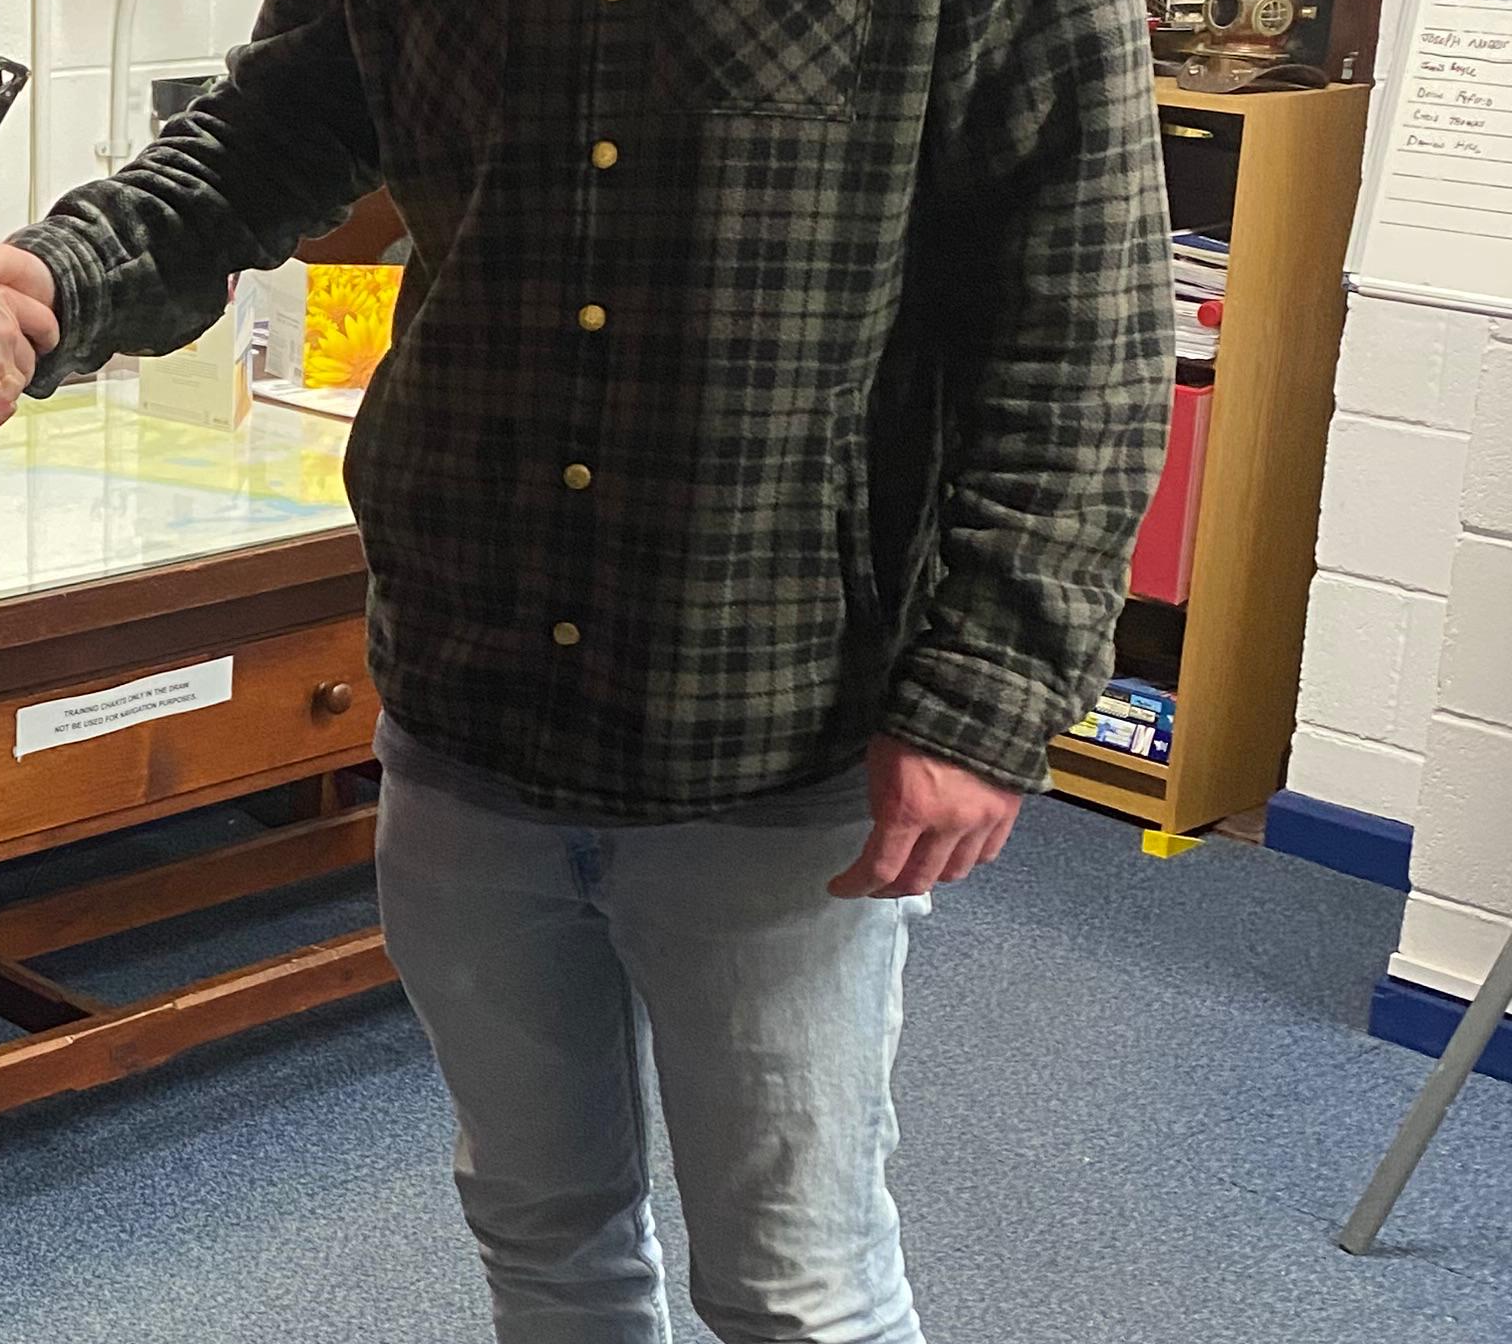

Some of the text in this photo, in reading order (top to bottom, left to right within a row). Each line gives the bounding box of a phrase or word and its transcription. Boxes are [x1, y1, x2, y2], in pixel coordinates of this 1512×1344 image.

[64, 705, 99, 718] TRAINING
[101, 698, 127, 711] CHARTS
[128, 692, 144, 703] ONLY
[145, 690, 153, 698] IN
[154, 686, 168, 697] THE
[54, 724, 70, 734] NOT
[71, 721, 83, 730] BE
[84, 716, 104, 728] USED
[105, 713, 120, 723] FOR
[120, 704, 158, 719] NAVIGATION
